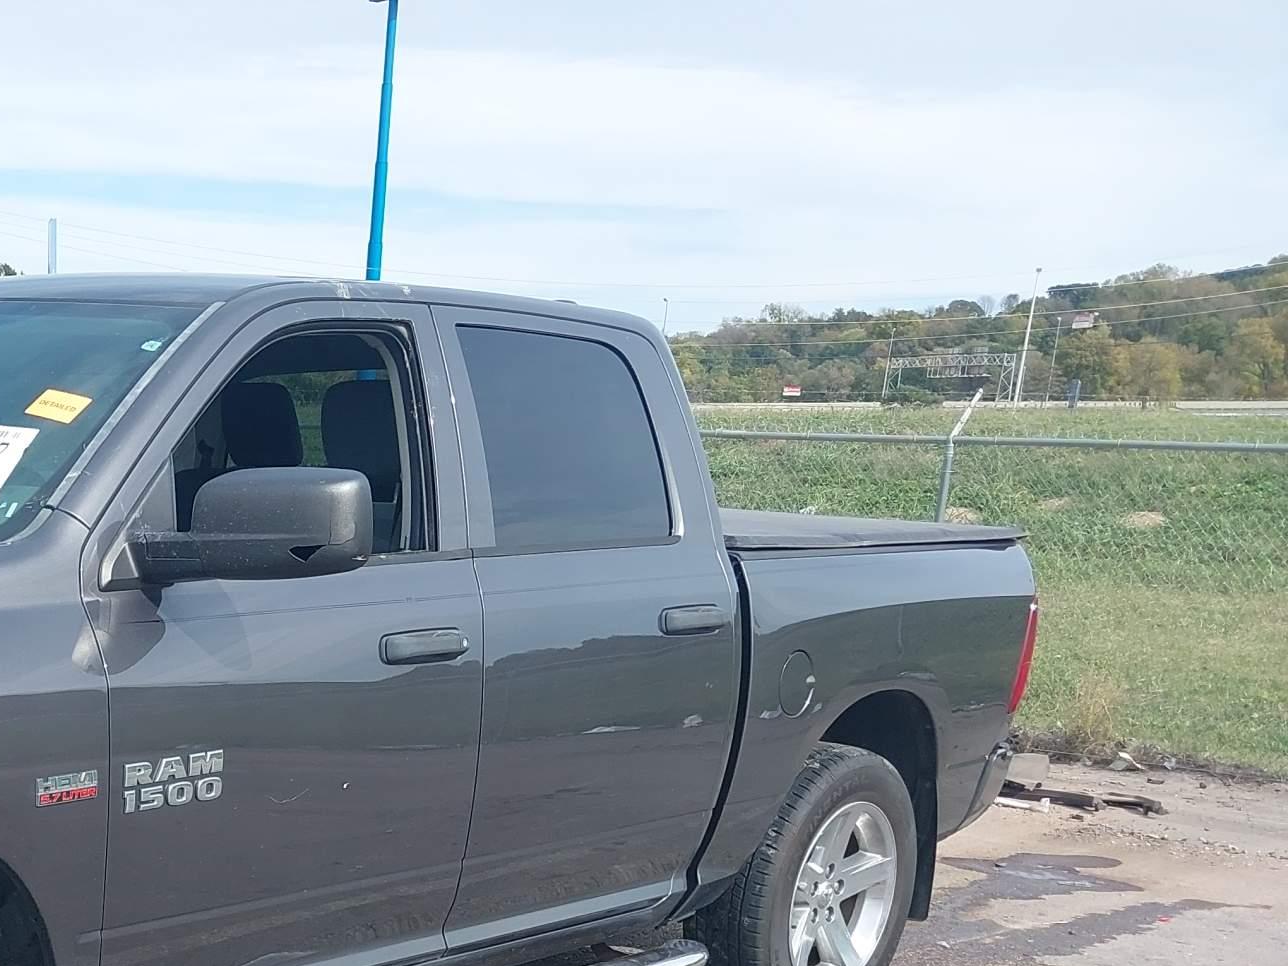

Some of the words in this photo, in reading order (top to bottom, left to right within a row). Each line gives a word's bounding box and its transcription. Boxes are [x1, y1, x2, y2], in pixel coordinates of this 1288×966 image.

[39, 400, 77, 412] DETAILED
[124, 749, 224, 788] RAM
[36, 770, 98, 793] HEMI
[40, 793, 62, 805] 5.7
[62, 787, 97, 802] LITER
[123, 776, 223, 814] 1500
